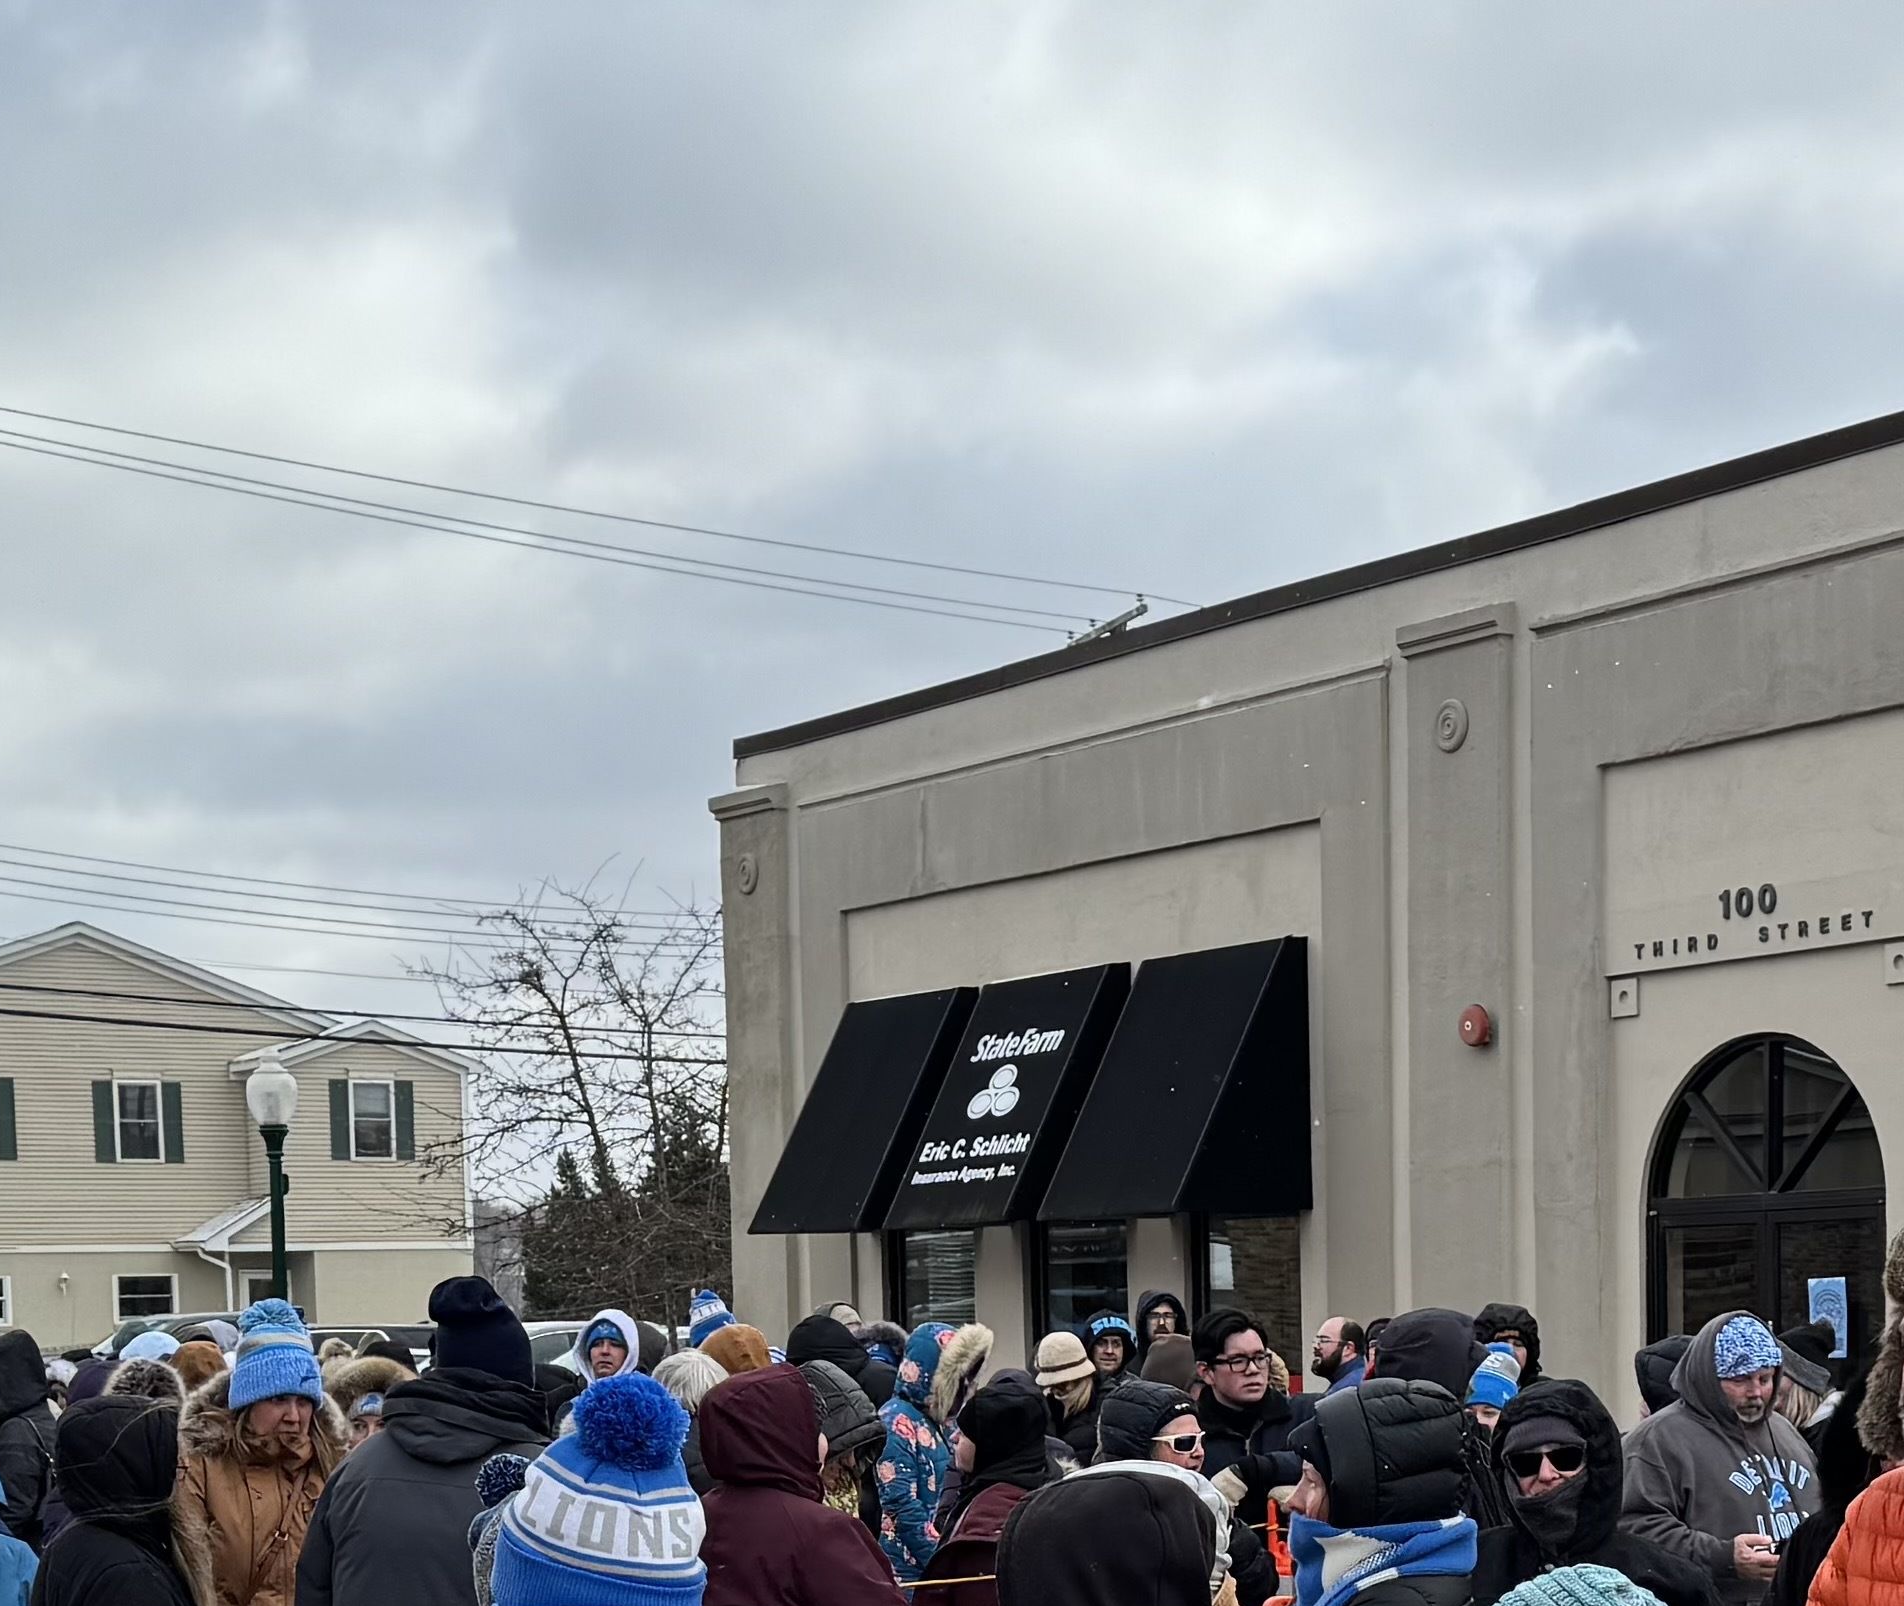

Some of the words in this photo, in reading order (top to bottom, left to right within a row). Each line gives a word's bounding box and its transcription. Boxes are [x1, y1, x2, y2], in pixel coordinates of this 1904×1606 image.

[1719, 883, 1777, 920] 100
[1634, 934, 1718, 960] THIRD
[1758, 910, 1873, 943] STREET
[919, 1141, 951, 1162] Eric
[952, 1139, 966, 1159] C.
[969, 1132, 1030, 1157] Schlicht
[911, 1171, 958, 1184] Insurance
[997, 1163, 1016, 1177] Inc.
[520, 1477, 692, 1559] LIONS
